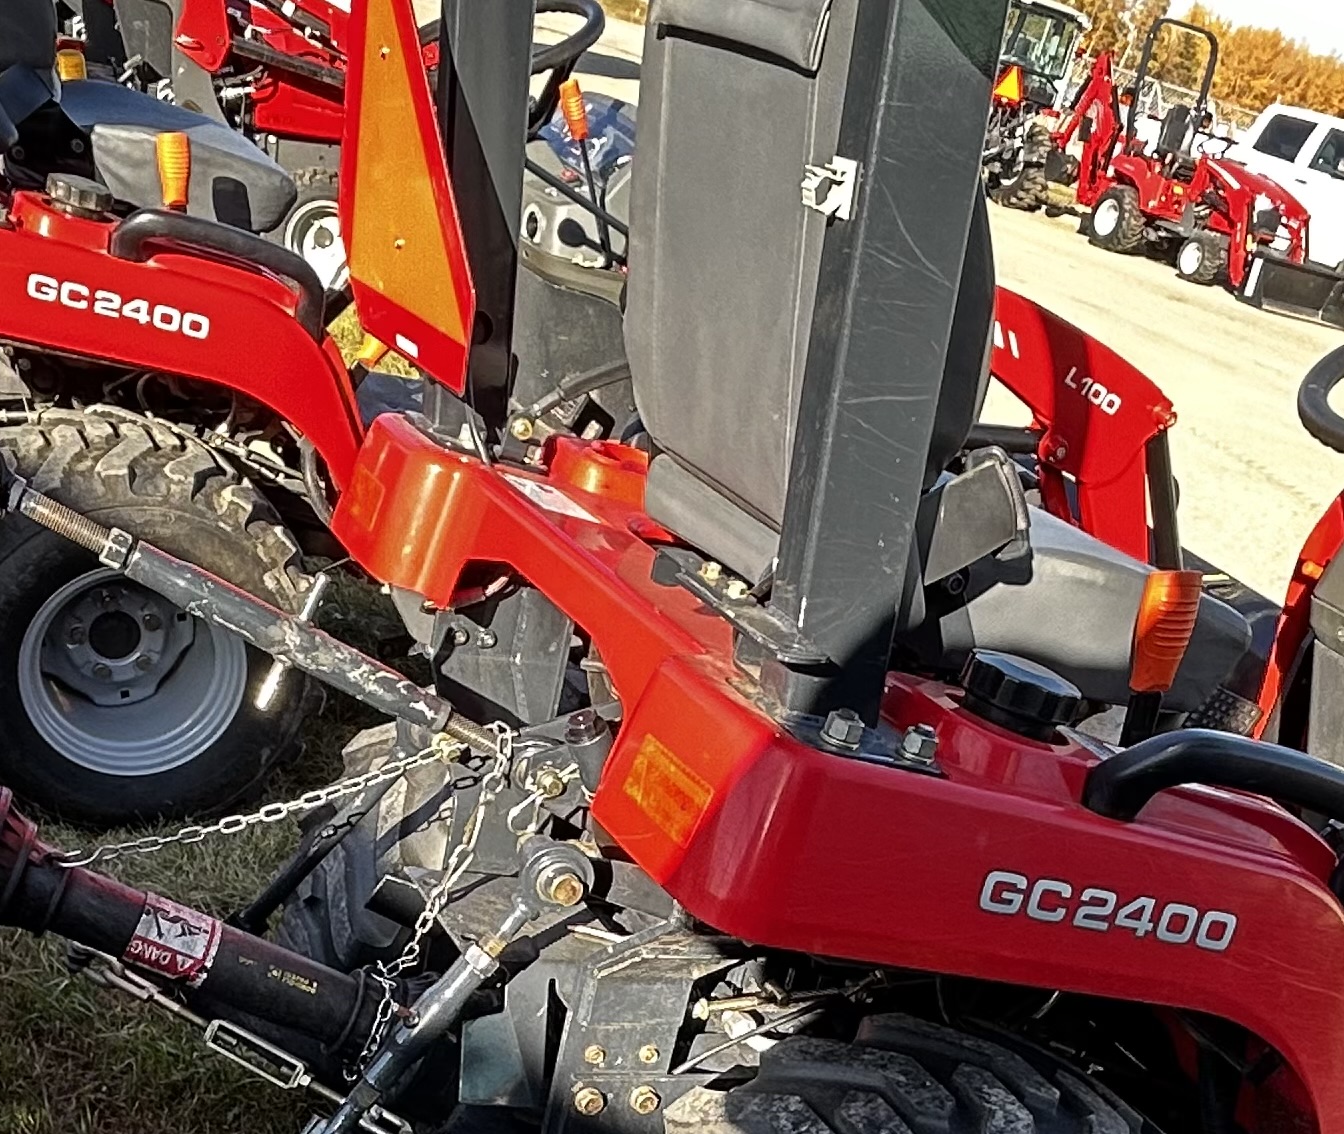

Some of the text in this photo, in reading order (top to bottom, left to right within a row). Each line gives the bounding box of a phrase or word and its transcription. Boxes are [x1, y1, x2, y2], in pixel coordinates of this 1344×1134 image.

[27, 273, 210, 340] GC2400
[979, 870, 1238, 951] GC2400
[127, 939, 173, 966] DANG
